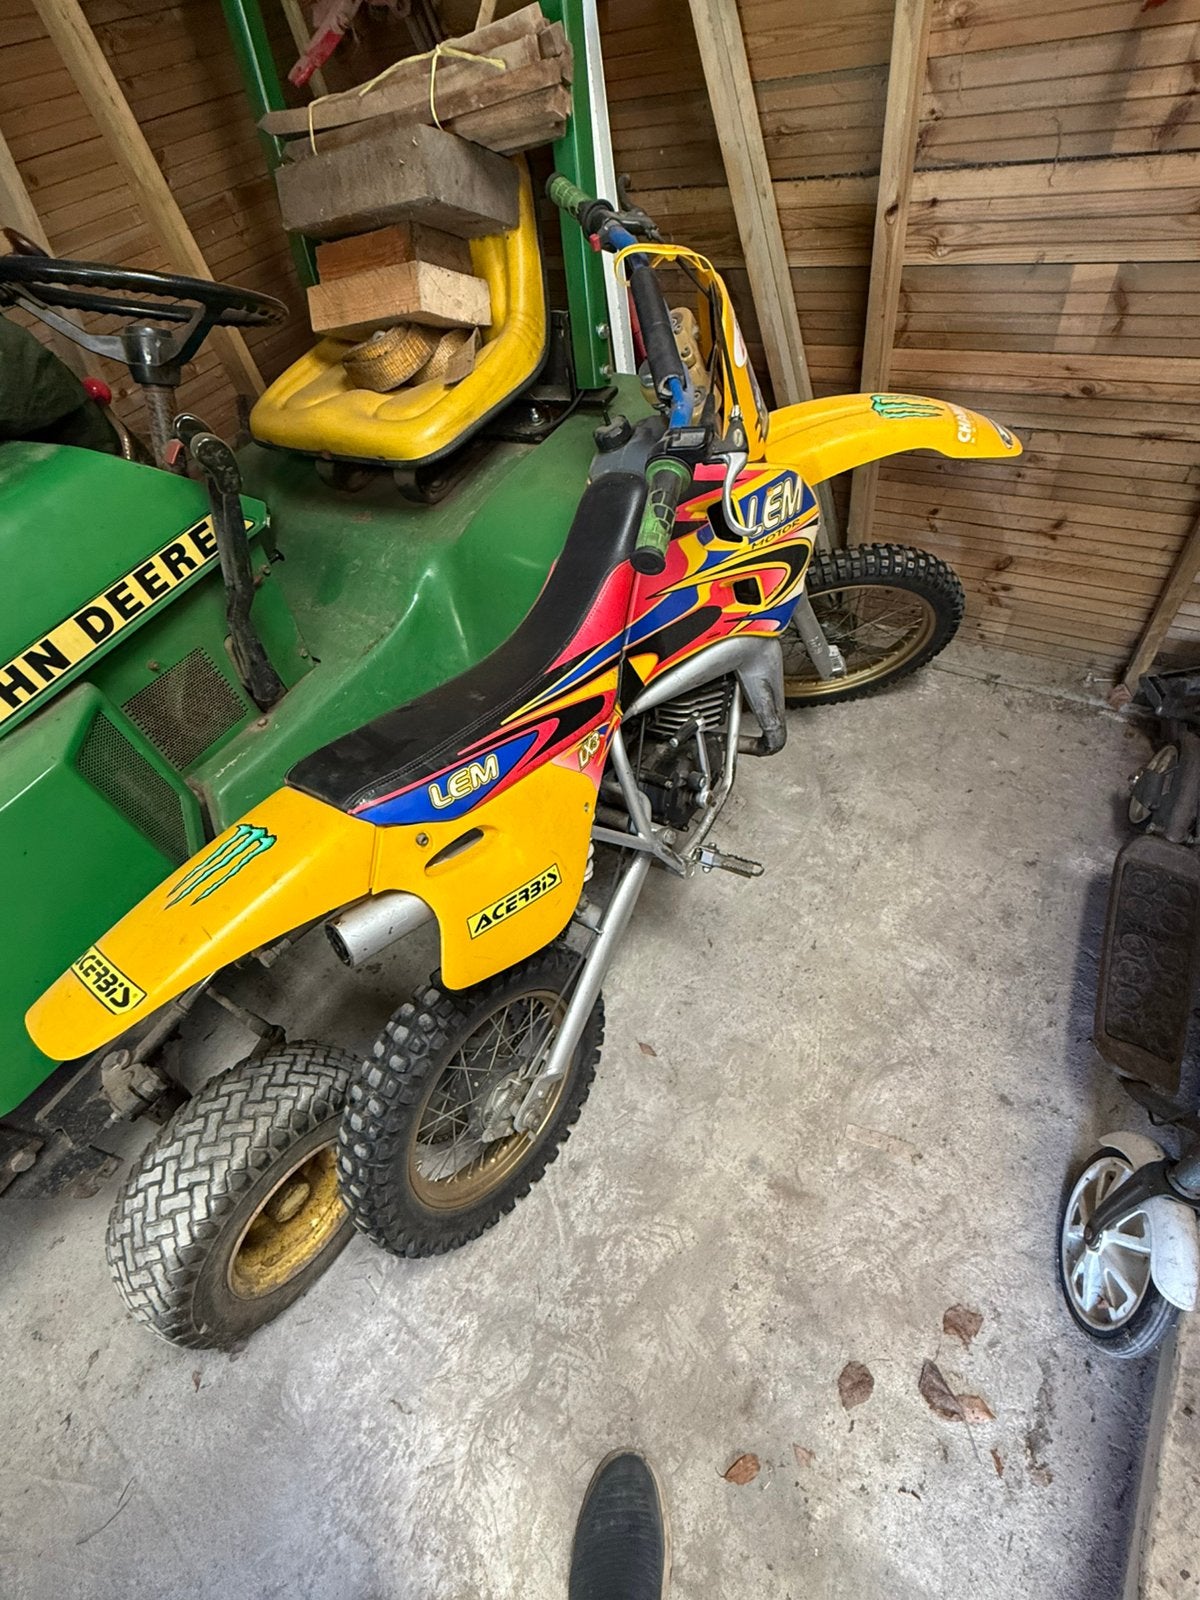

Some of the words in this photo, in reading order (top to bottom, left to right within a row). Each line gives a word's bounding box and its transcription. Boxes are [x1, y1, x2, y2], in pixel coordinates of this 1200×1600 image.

[746, 477, 804, 538] LEM
[751, 519, 800, 549] MOTOR
[74, 521, 219, 645] DEERE
[428, 753, 499, 809] LEM
[76, 951, 130, 1008] CERBiS
